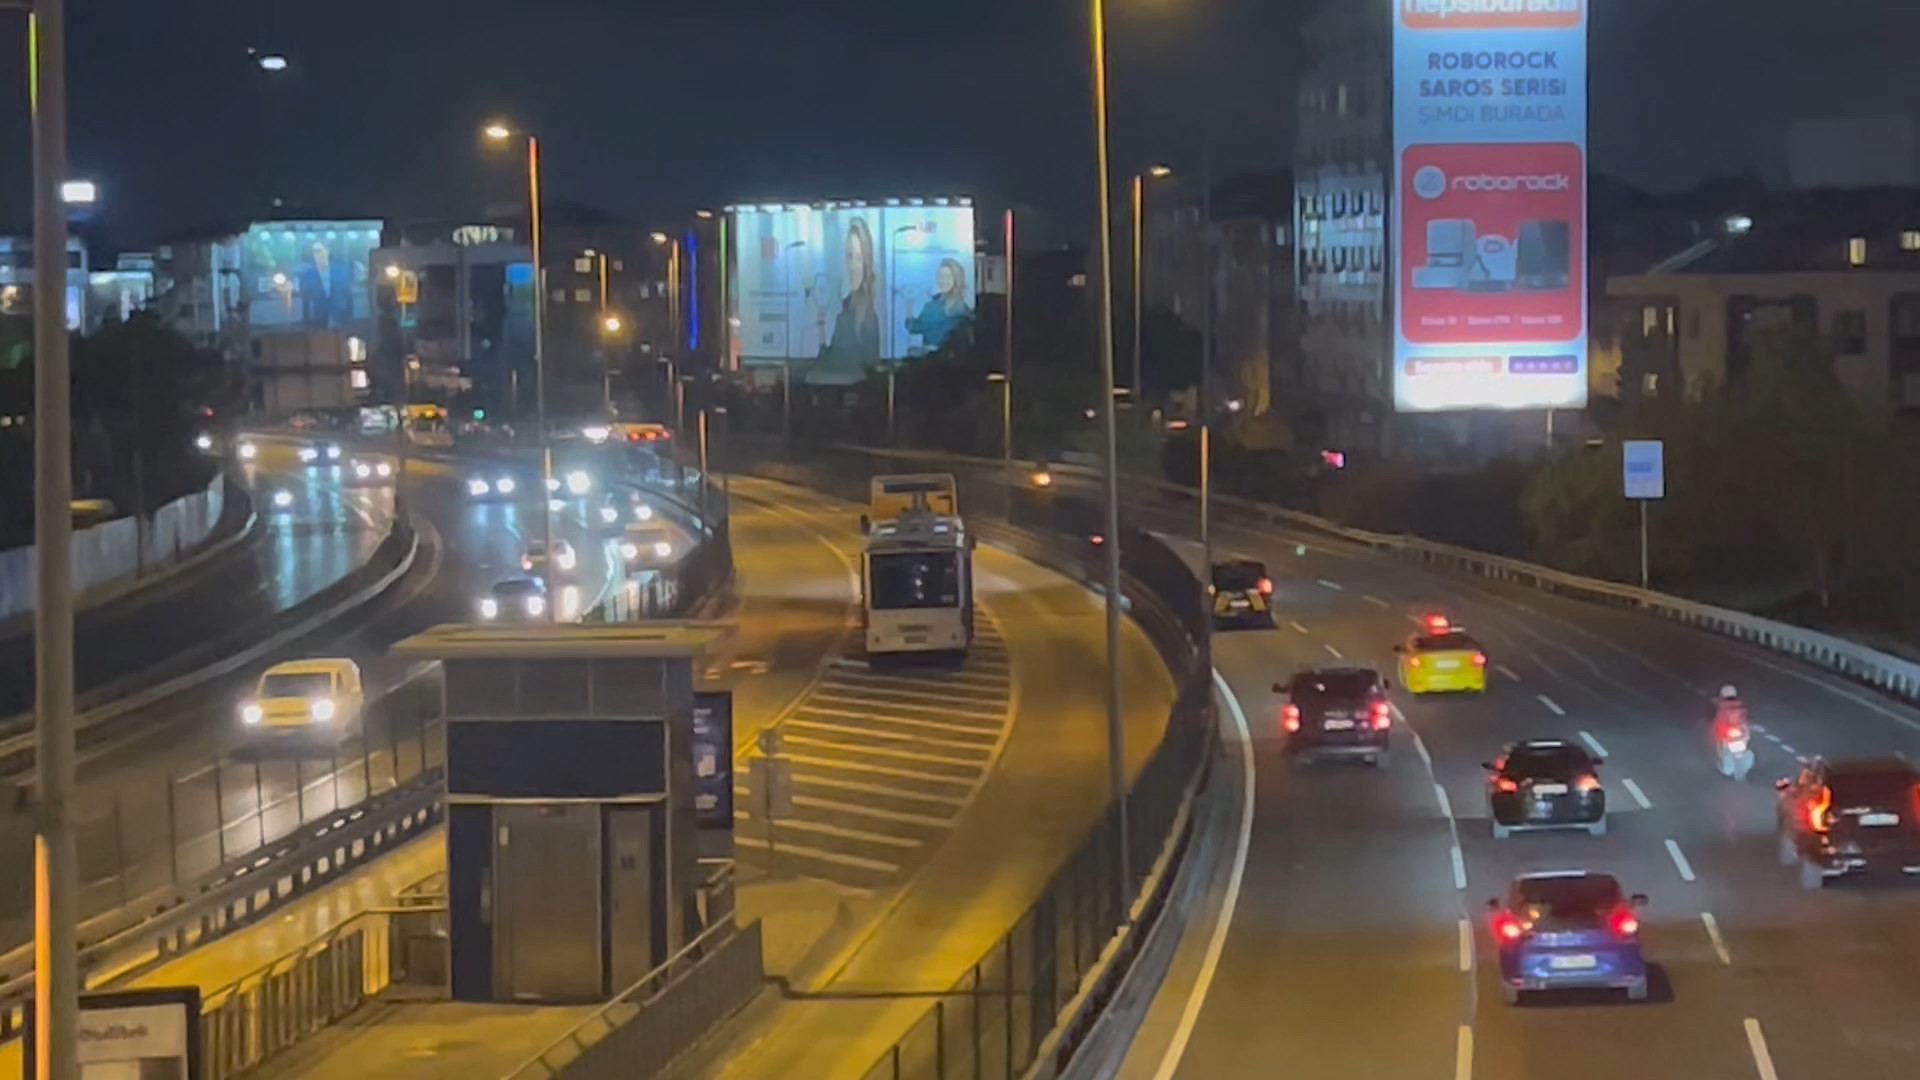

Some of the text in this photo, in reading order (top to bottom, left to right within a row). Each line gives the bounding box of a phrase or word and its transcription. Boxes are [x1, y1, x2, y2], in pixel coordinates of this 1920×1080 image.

[1428, 52, 1558, 70] ROBOROCK
[1420, 79, 1494, 97] SAROS
[1480, 103, 1566, 122] BURADA
[1451, 172, 1570, 191] roborock
